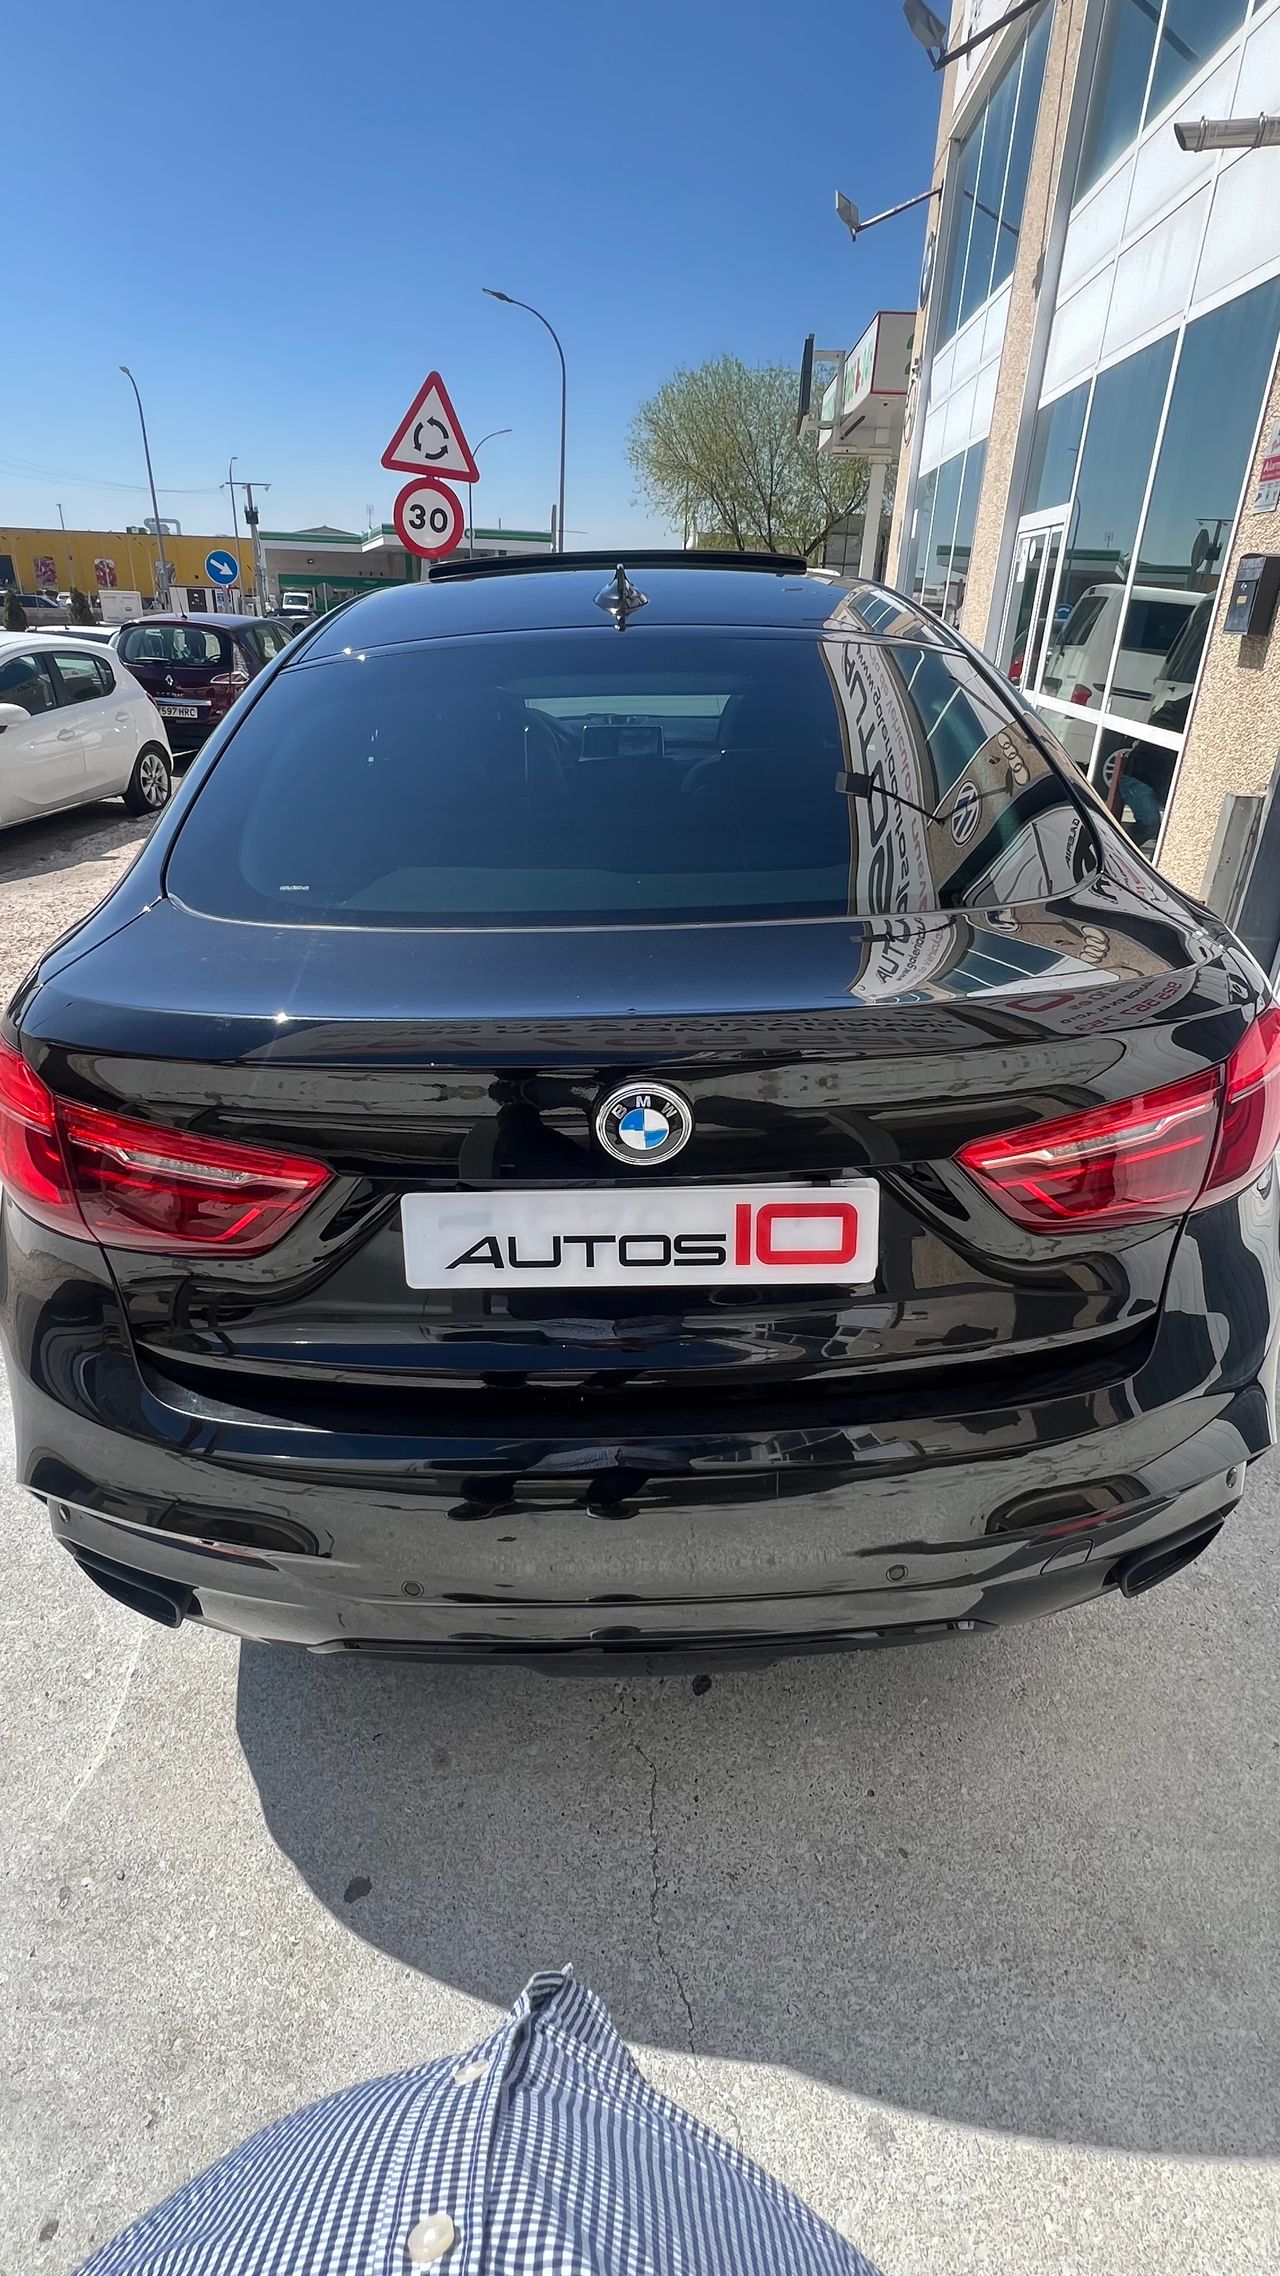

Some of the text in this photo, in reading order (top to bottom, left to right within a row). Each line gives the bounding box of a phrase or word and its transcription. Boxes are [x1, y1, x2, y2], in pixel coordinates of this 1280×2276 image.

[408, 504, 448, 533] 30
[178, 707, 196, 717] HRC
[611, 1094, 680, 1119] BMW
